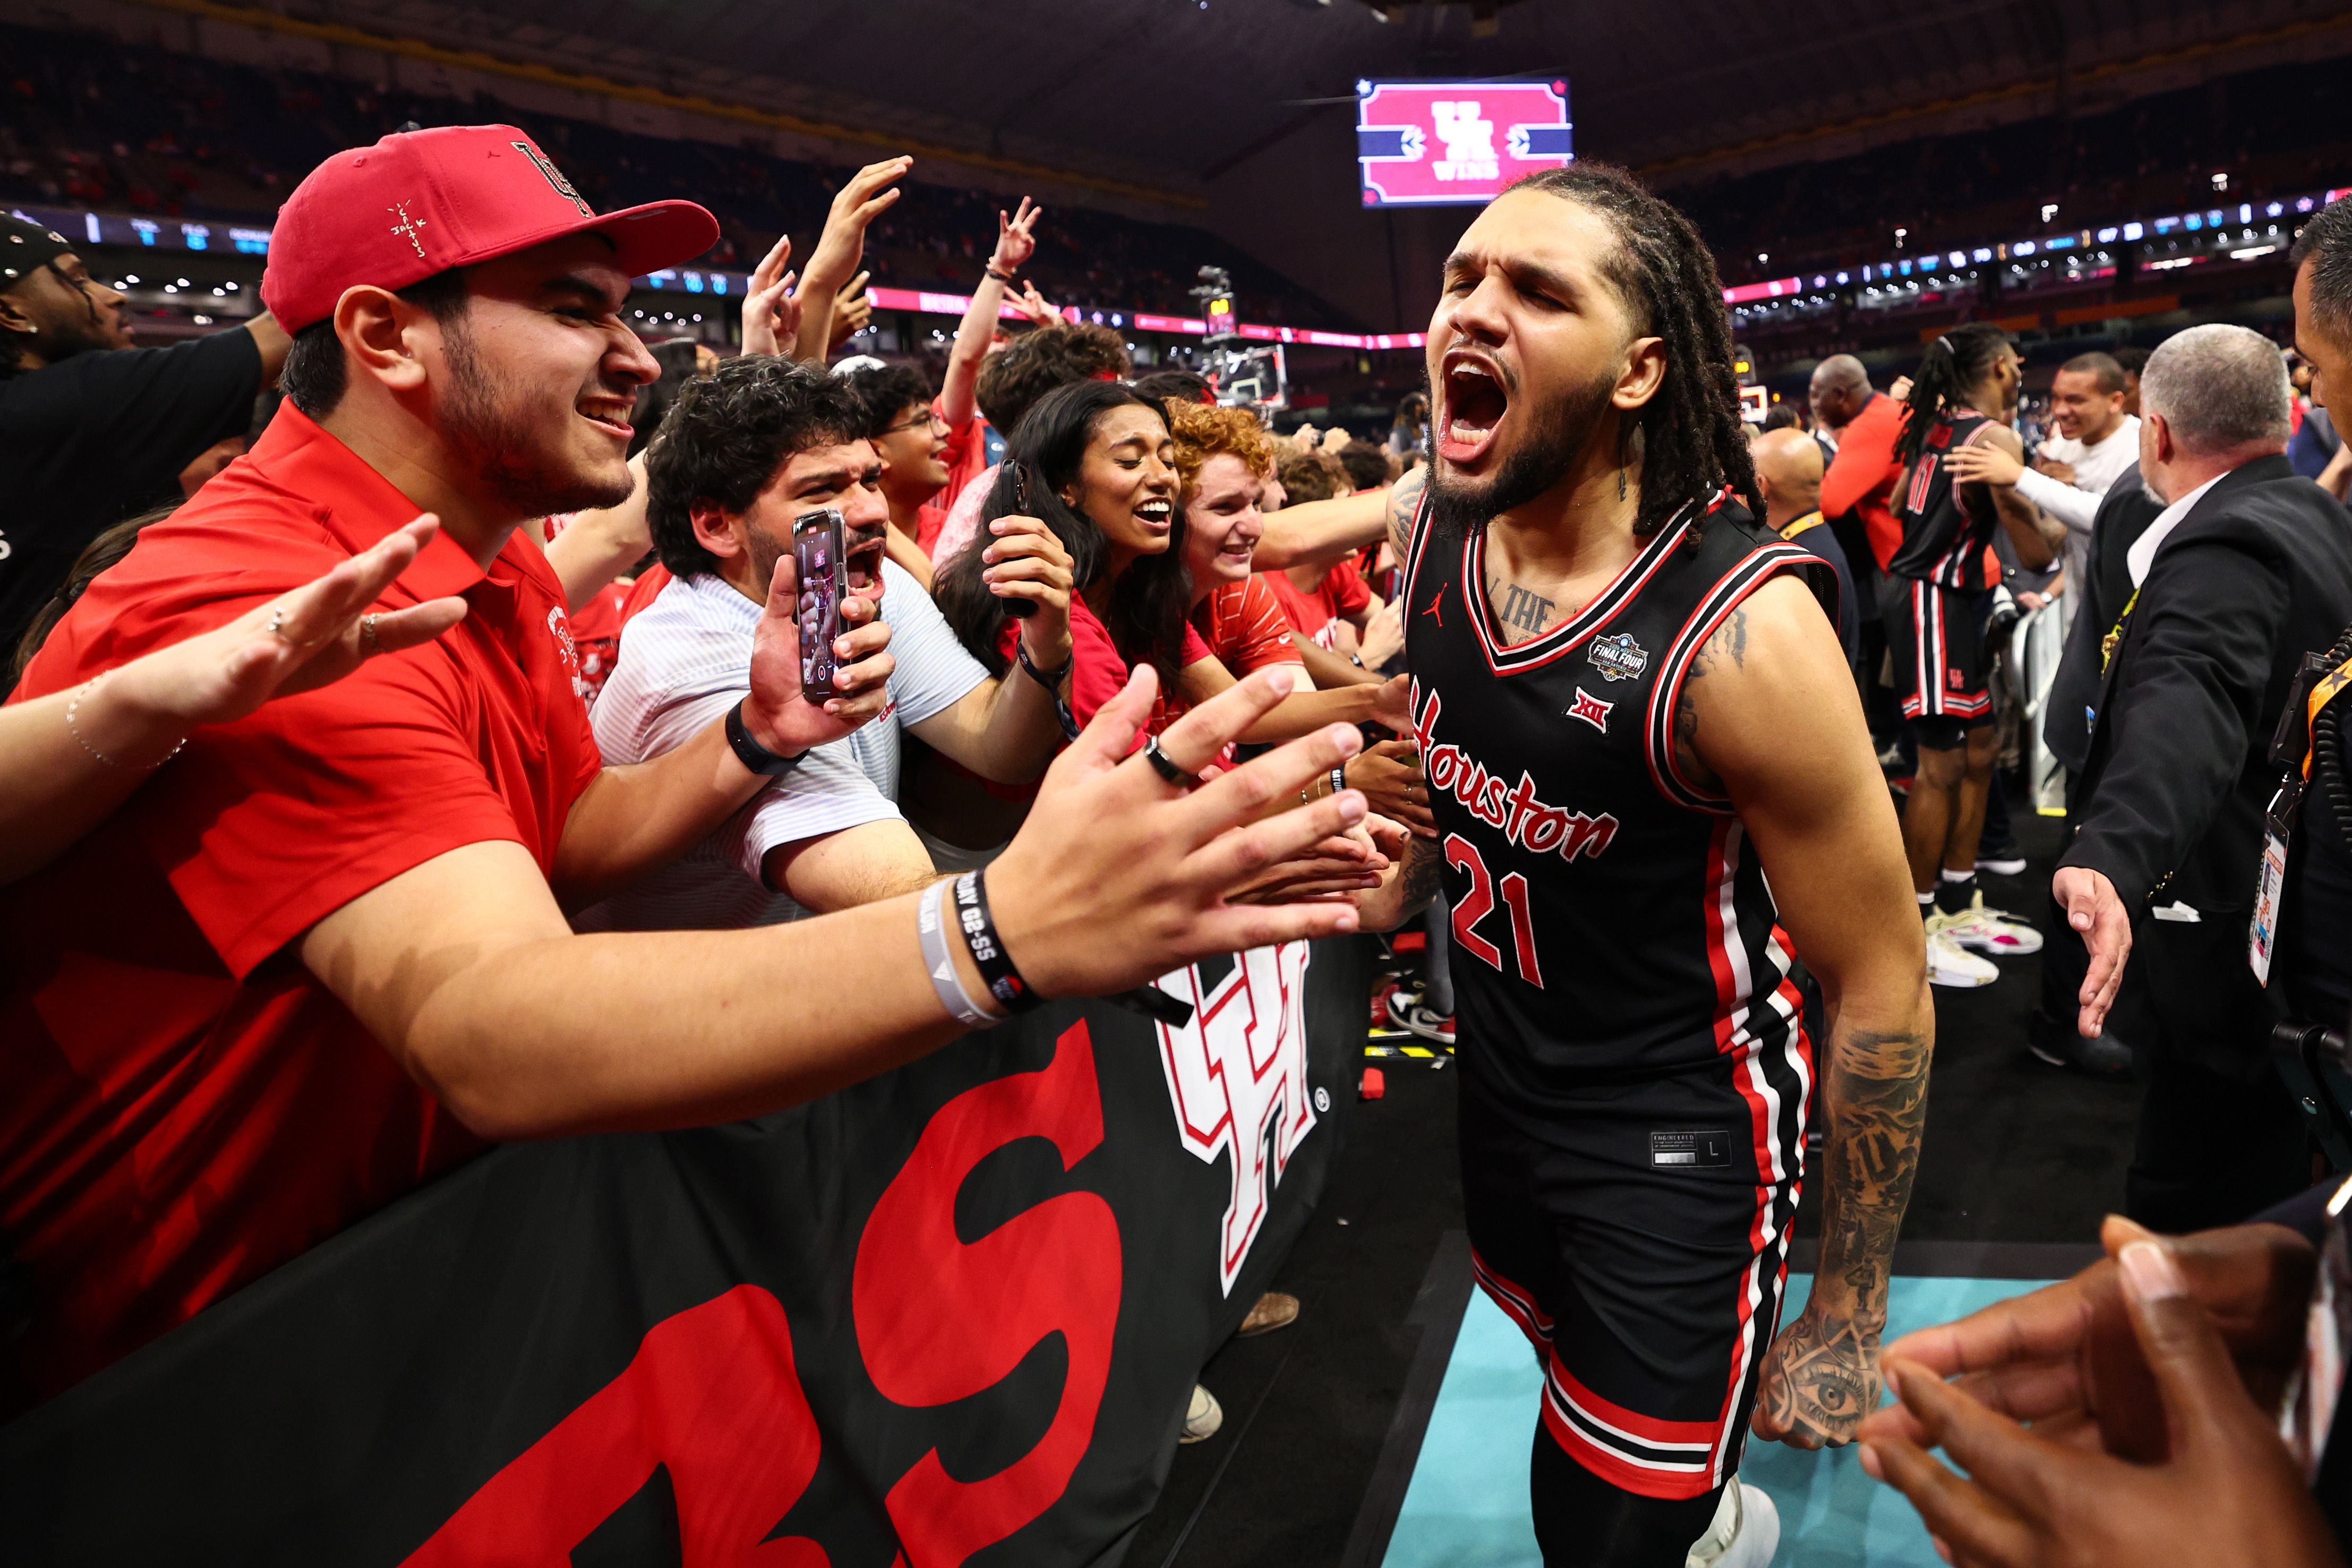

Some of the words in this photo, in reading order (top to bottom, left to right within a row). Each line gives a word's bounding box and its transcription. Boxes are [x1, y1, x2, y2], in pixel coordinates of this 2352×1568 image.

[1433, 161, 1499, 180] WINS
[1906, 452, 1938, 515] 11
[1501, 584, 1555, 635] THE
[1593, 644, 1620, 661] FINAL
[1618, 653, 1644, 669] FOUR
[1409, 674, 1620, 863] Houston
[1443, 832, 1544, 990] 21
[1709, 1142, 1718, 1156] L
